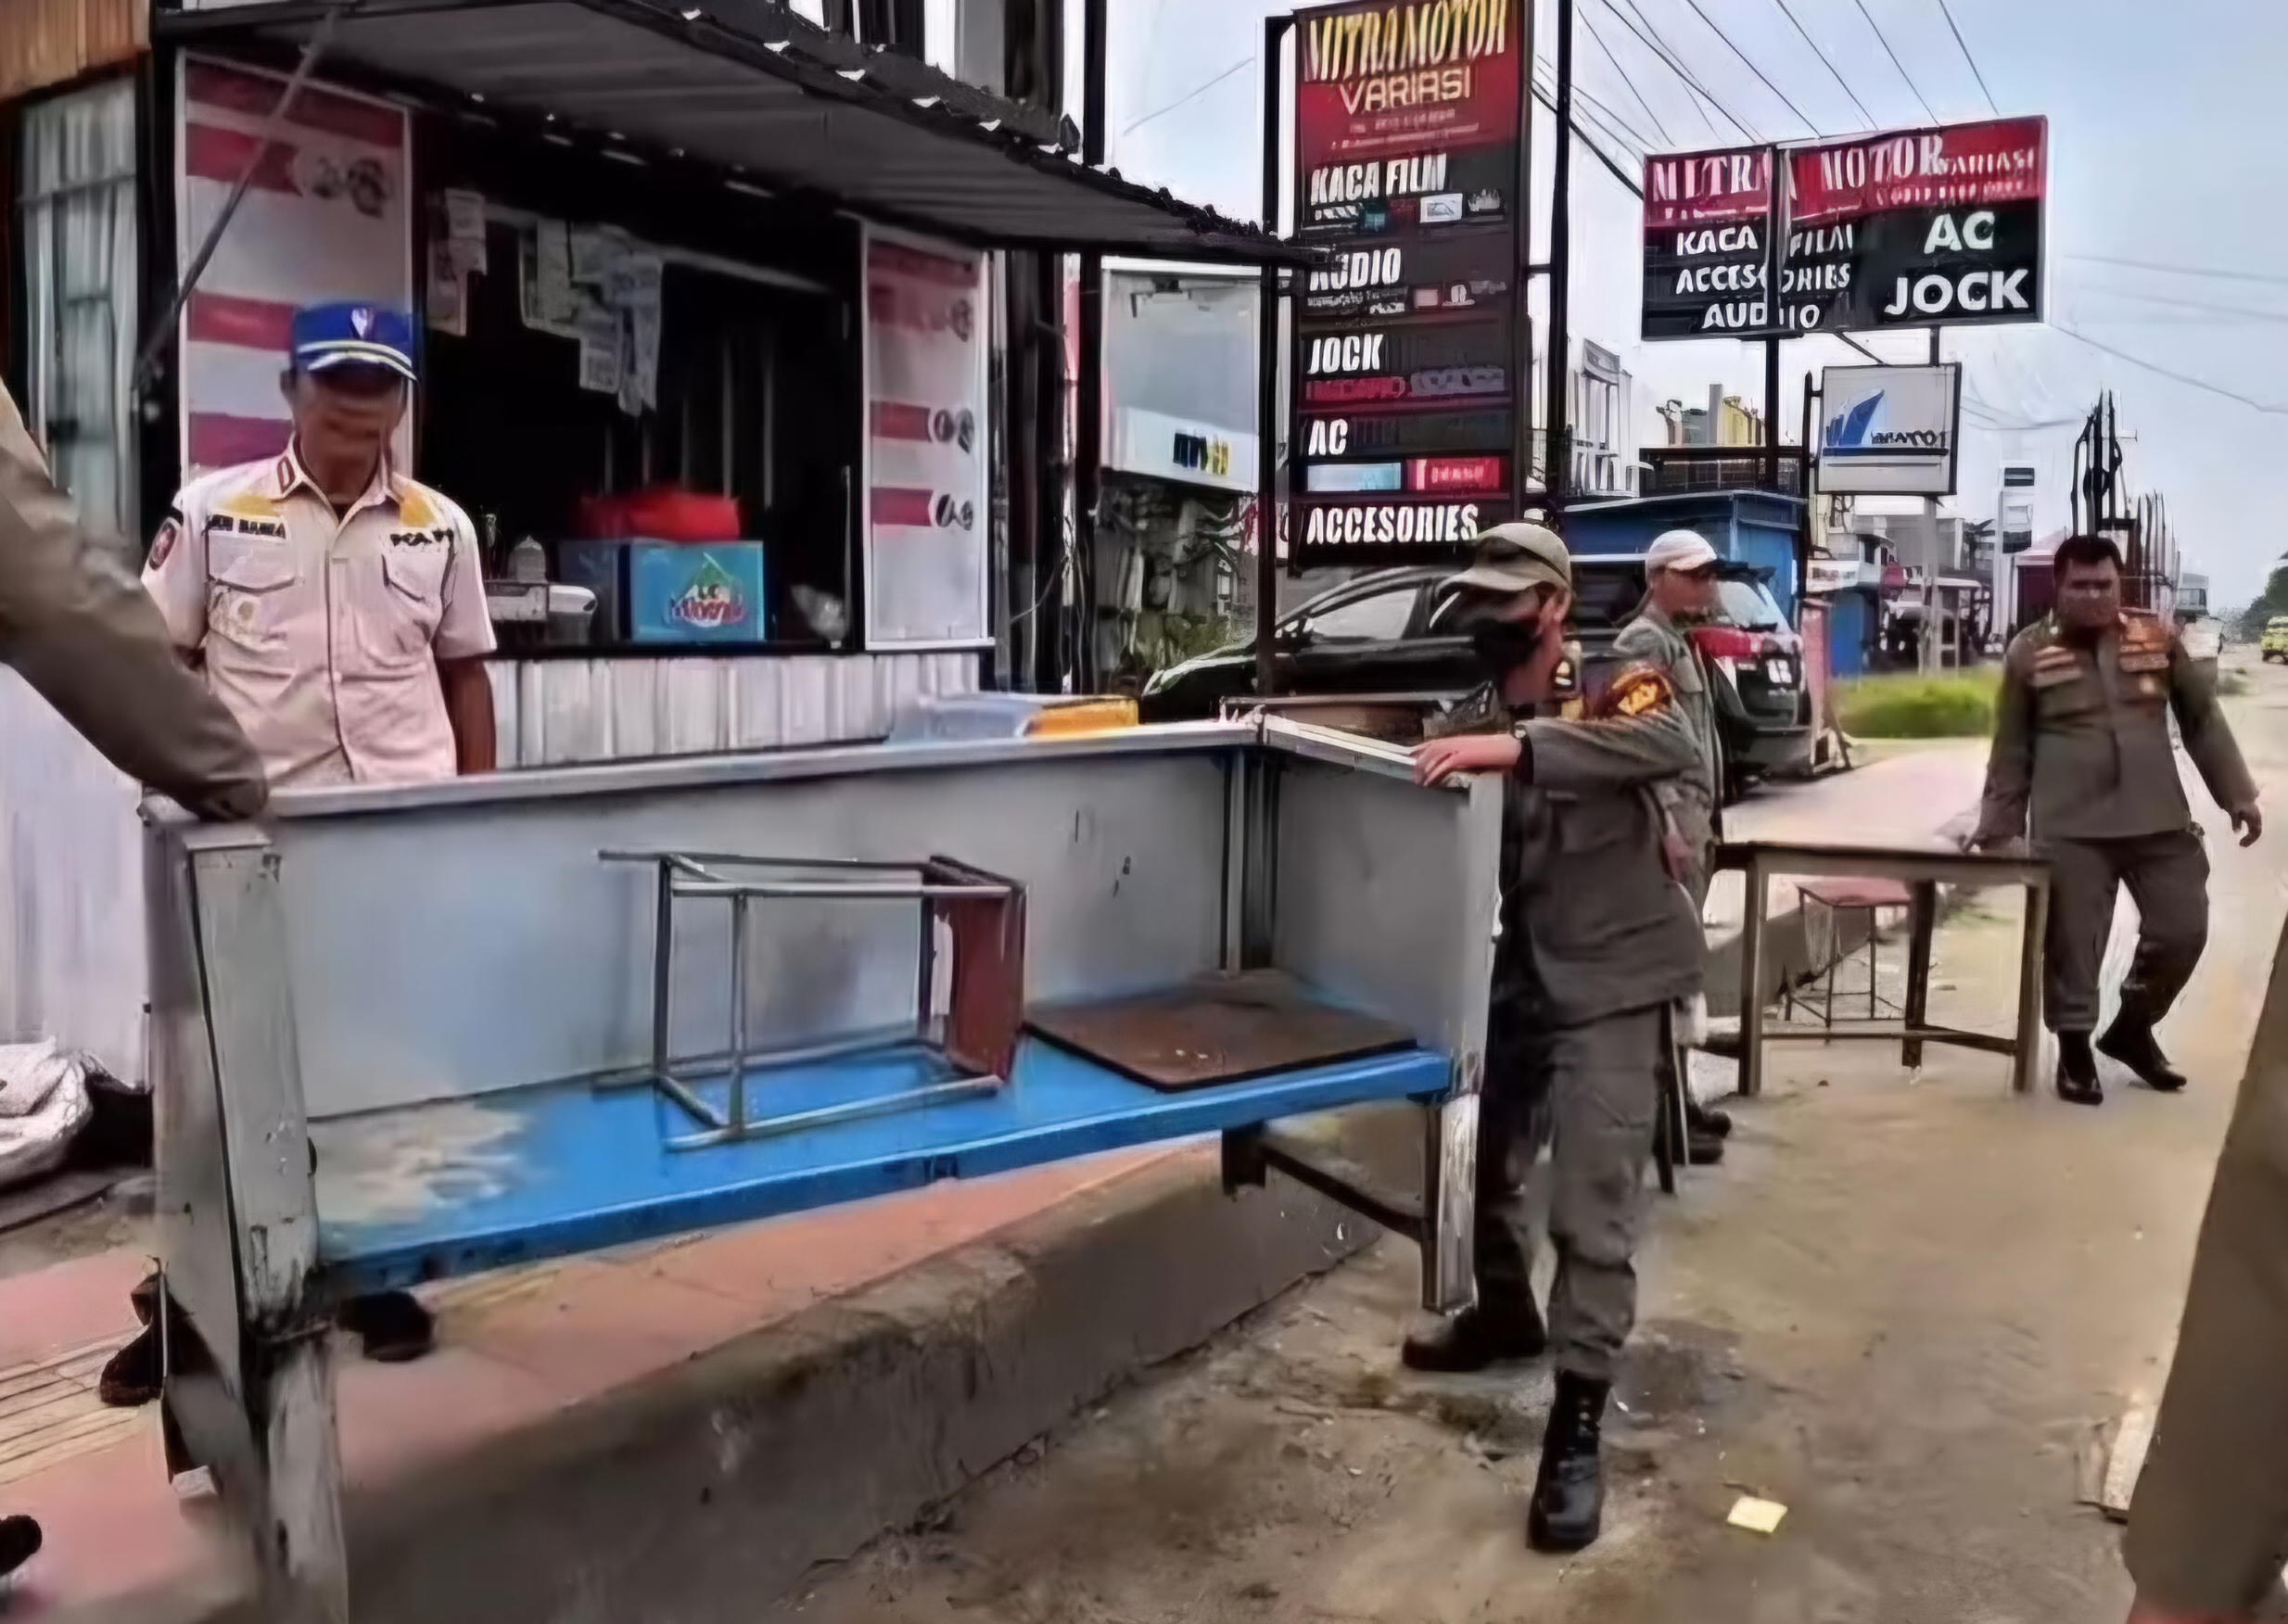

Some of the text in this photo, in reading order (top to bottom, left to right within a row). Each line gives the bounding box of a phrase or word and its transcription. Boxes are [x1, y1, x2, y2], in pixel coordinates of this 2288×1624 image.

[1340, 67, 1471, 115] VARIASI
[1311, 153, 1447, 206] KACA FILM
[1676, 225, 1759, 256] KACA
[1924, 211, 1995, 254] AC
[1884, 268, 2029, 315] JOCK
[1308, 334, 1384, 374] JOCK
[1308, 418, 1349, 455] AC
[1306, 504, 1479, 544] ACCESORIES
